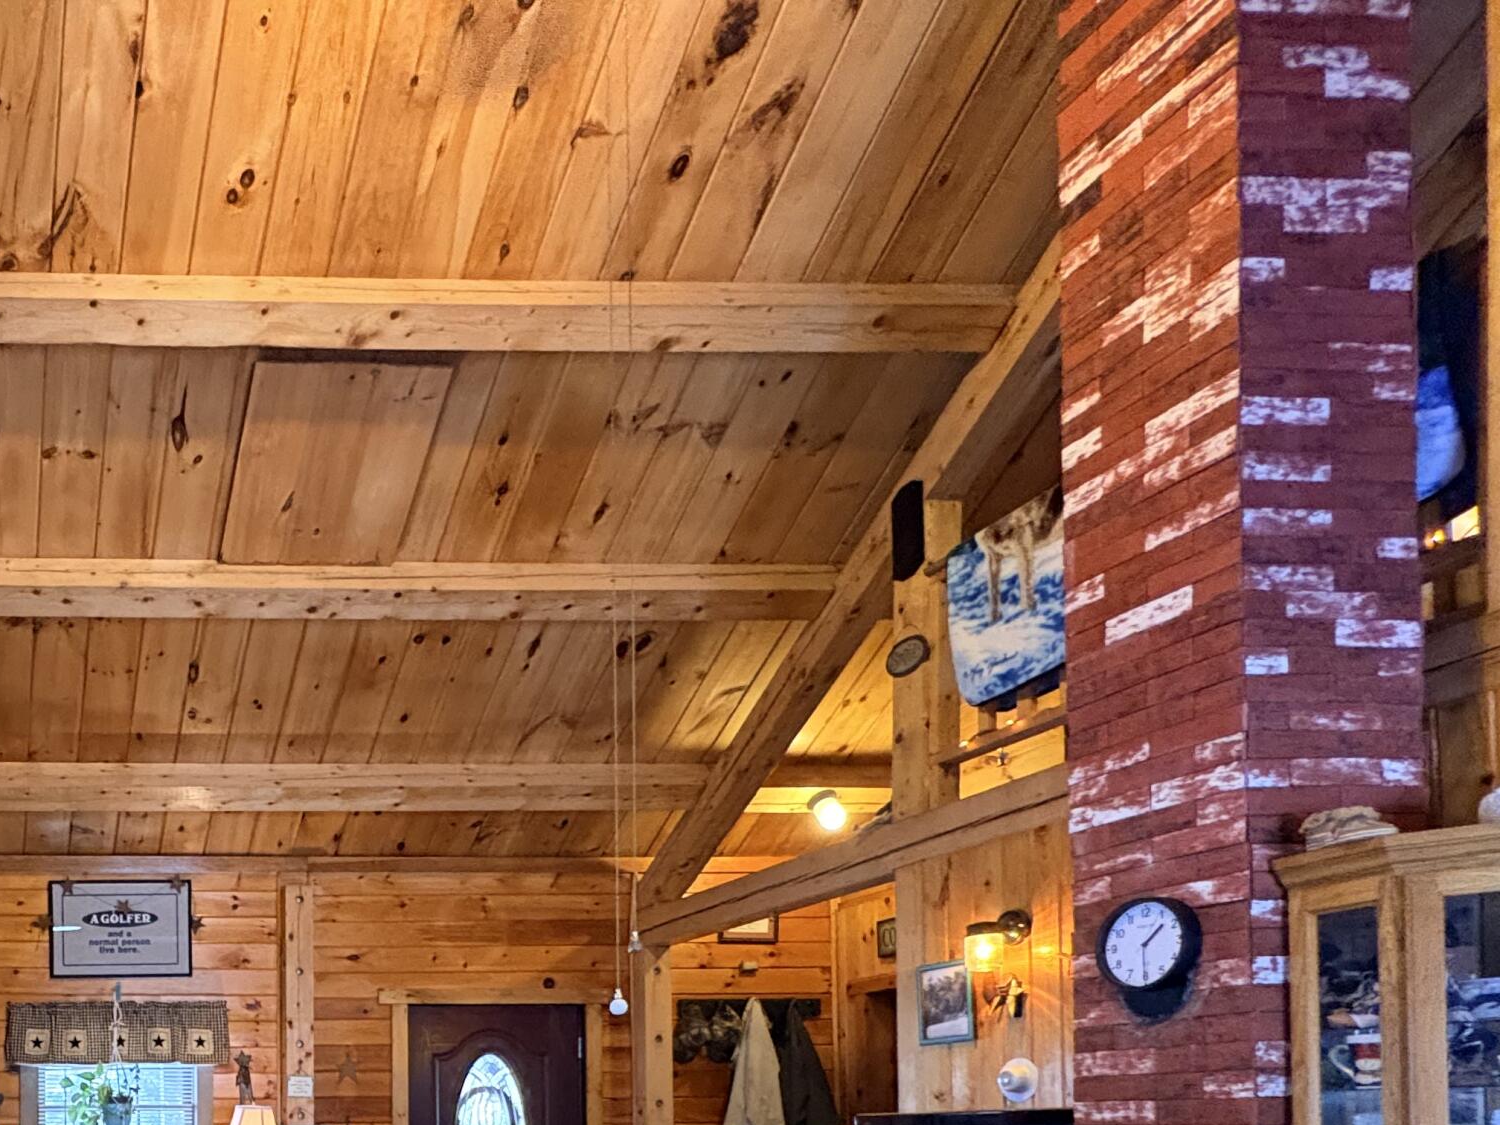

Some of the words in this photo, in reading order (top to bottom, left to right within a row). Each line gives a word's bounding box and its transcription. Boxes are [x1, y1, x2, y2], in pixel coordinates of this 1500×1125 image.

[1141, 907, 1151, 918] 12
[1159, 910, 1164, 919] 1
[91, 914, 99, 924] A
[100, 913, 151, 924] GOLFER
[1171, 919, 1178, 929] 2
[107, 930, 124, 938] and
[1115, 929, 1125, 939] 10
[88, 938, 119, 946] normal
[121, 938, 151, 947] person
[99, 946, 115, 954] live
[1112, 945, 1118, 954] 9
[1116, 960, 1122, 969] 8
[1125, 969, 1134, 979] 7
[1158, 965, 1166, 975] 5
